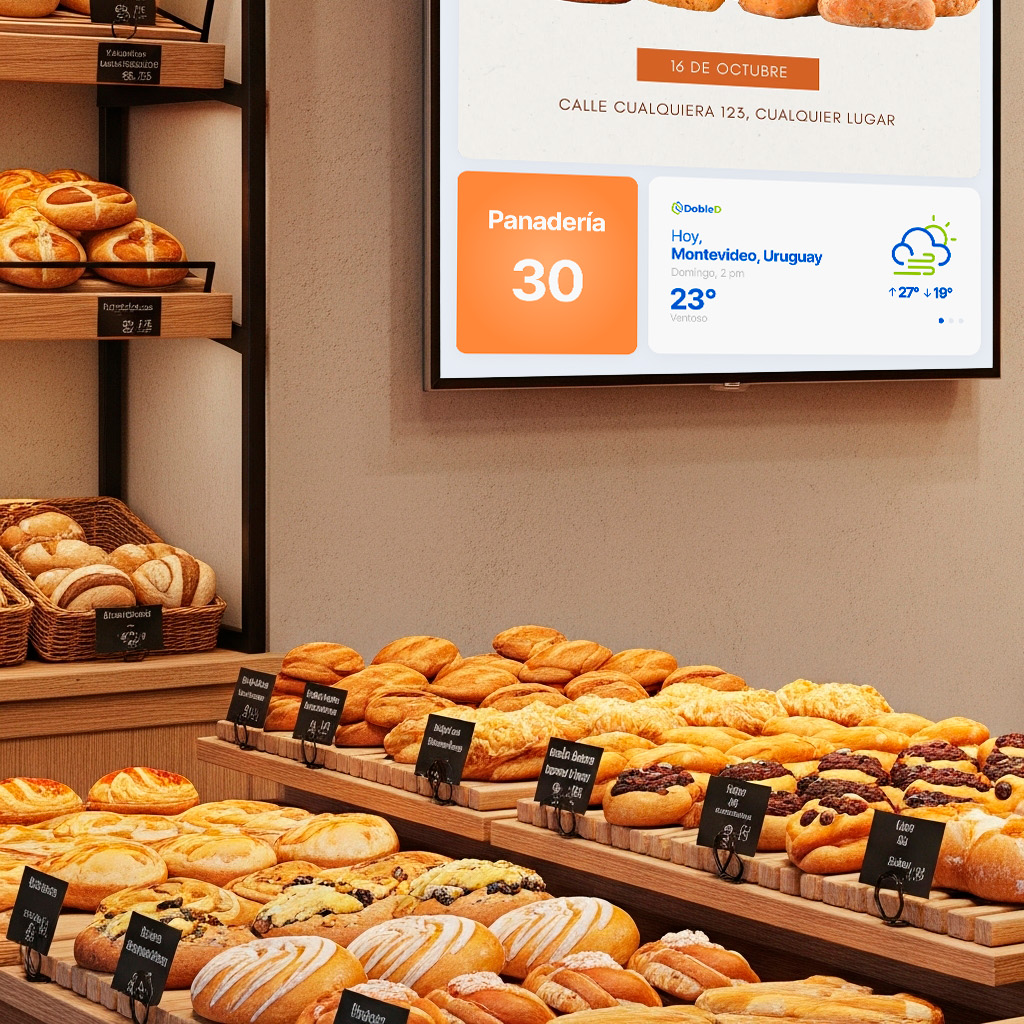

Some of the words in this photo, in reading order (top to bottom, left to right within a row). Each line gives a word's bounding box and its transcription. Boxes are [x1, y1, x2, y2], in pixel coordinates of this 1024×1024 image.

[671, 60, 684, 72] 16
[691, 61, 709, 73] DE
[718, 63, 788, 78] OCTUBRE
[559, 98, 606, 112] CALLE
[614, 101, 714, 117] CUALQUIERA
[721, 106, 749, 121] 123,
[756, 108, 840, 123] CUALQUIER
[848, 113, 895, 126] LUGAR
[684, 205, 722, 213] DobleD
[488, 210, 606, 233] Panadería
[672, 230, 702, 245] Hoy,
[671, 247, 760, 264] Montevideo,
[764, 250, 822, 266] Uruguay
[512, 259, 583, 302] 30
[671, 267, 718, 279] Domingo,
[720, 269, 727, 278] 2
[729, 271, 745, 279] pm
[671, 288, 716, 310] 23°
[899, 286, 919, 298] 27°
[934, 287, 953, 299] 19°
[670, 313, 708, 323] Ventoso
